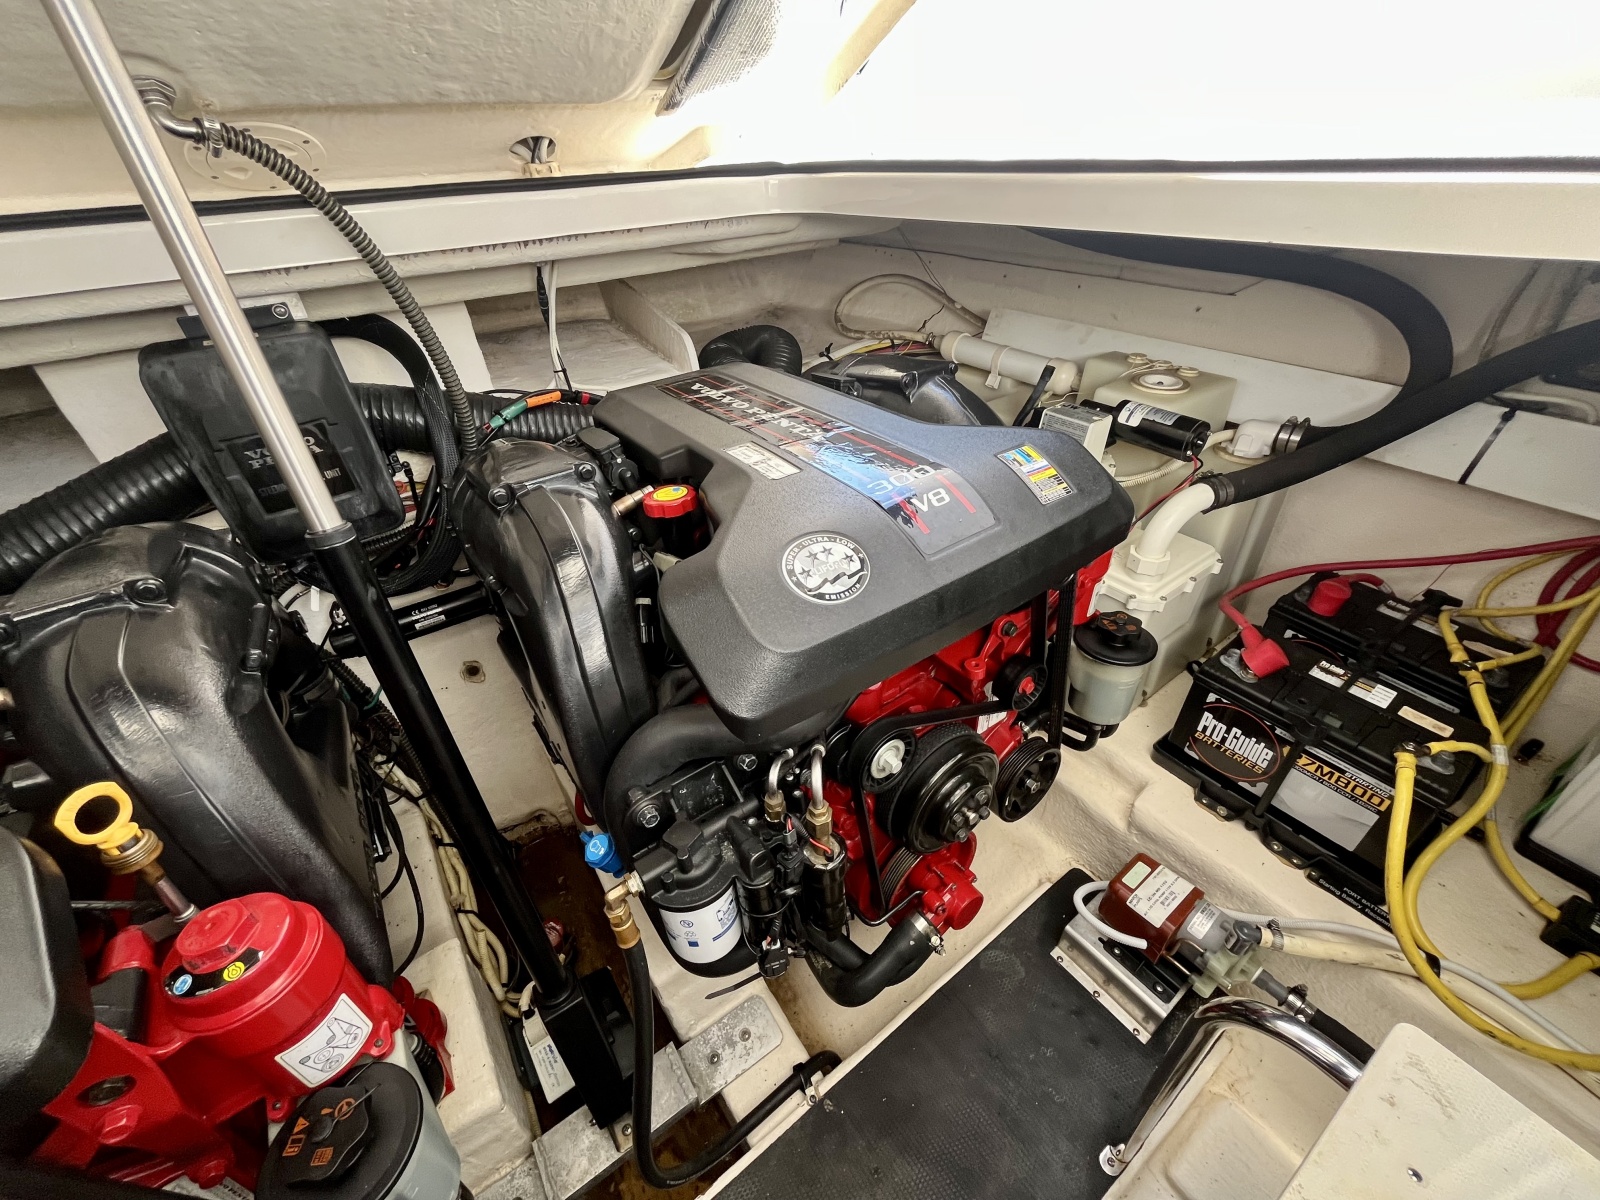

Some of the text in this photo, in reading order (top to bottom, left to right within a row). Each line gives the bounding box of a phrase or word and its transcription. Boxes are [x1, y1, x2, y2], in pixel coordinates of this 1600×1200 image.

[690, 382, 826, 443] VOLVO PENTA
[244, 436, 315, 459] VOO
[248, 445, 324, 469] PEA
[867, 465, 936, 495] 300
[910, 487, 951, 513] V8
[786, 536, 856, 570] SUPER ULTRA LOW
[825, 582, 861, 600] EMISSION
[1194, 731, 1265, 774] BATTERIES
[1197, 711, 1274, 769] Pro-Guide
[1344, 772, 1390, 799] STARTING
[1319, 878, 1392, 929] Starting Battery Recomm
[1343, 887, 1391, 920] PORT BATTERY
